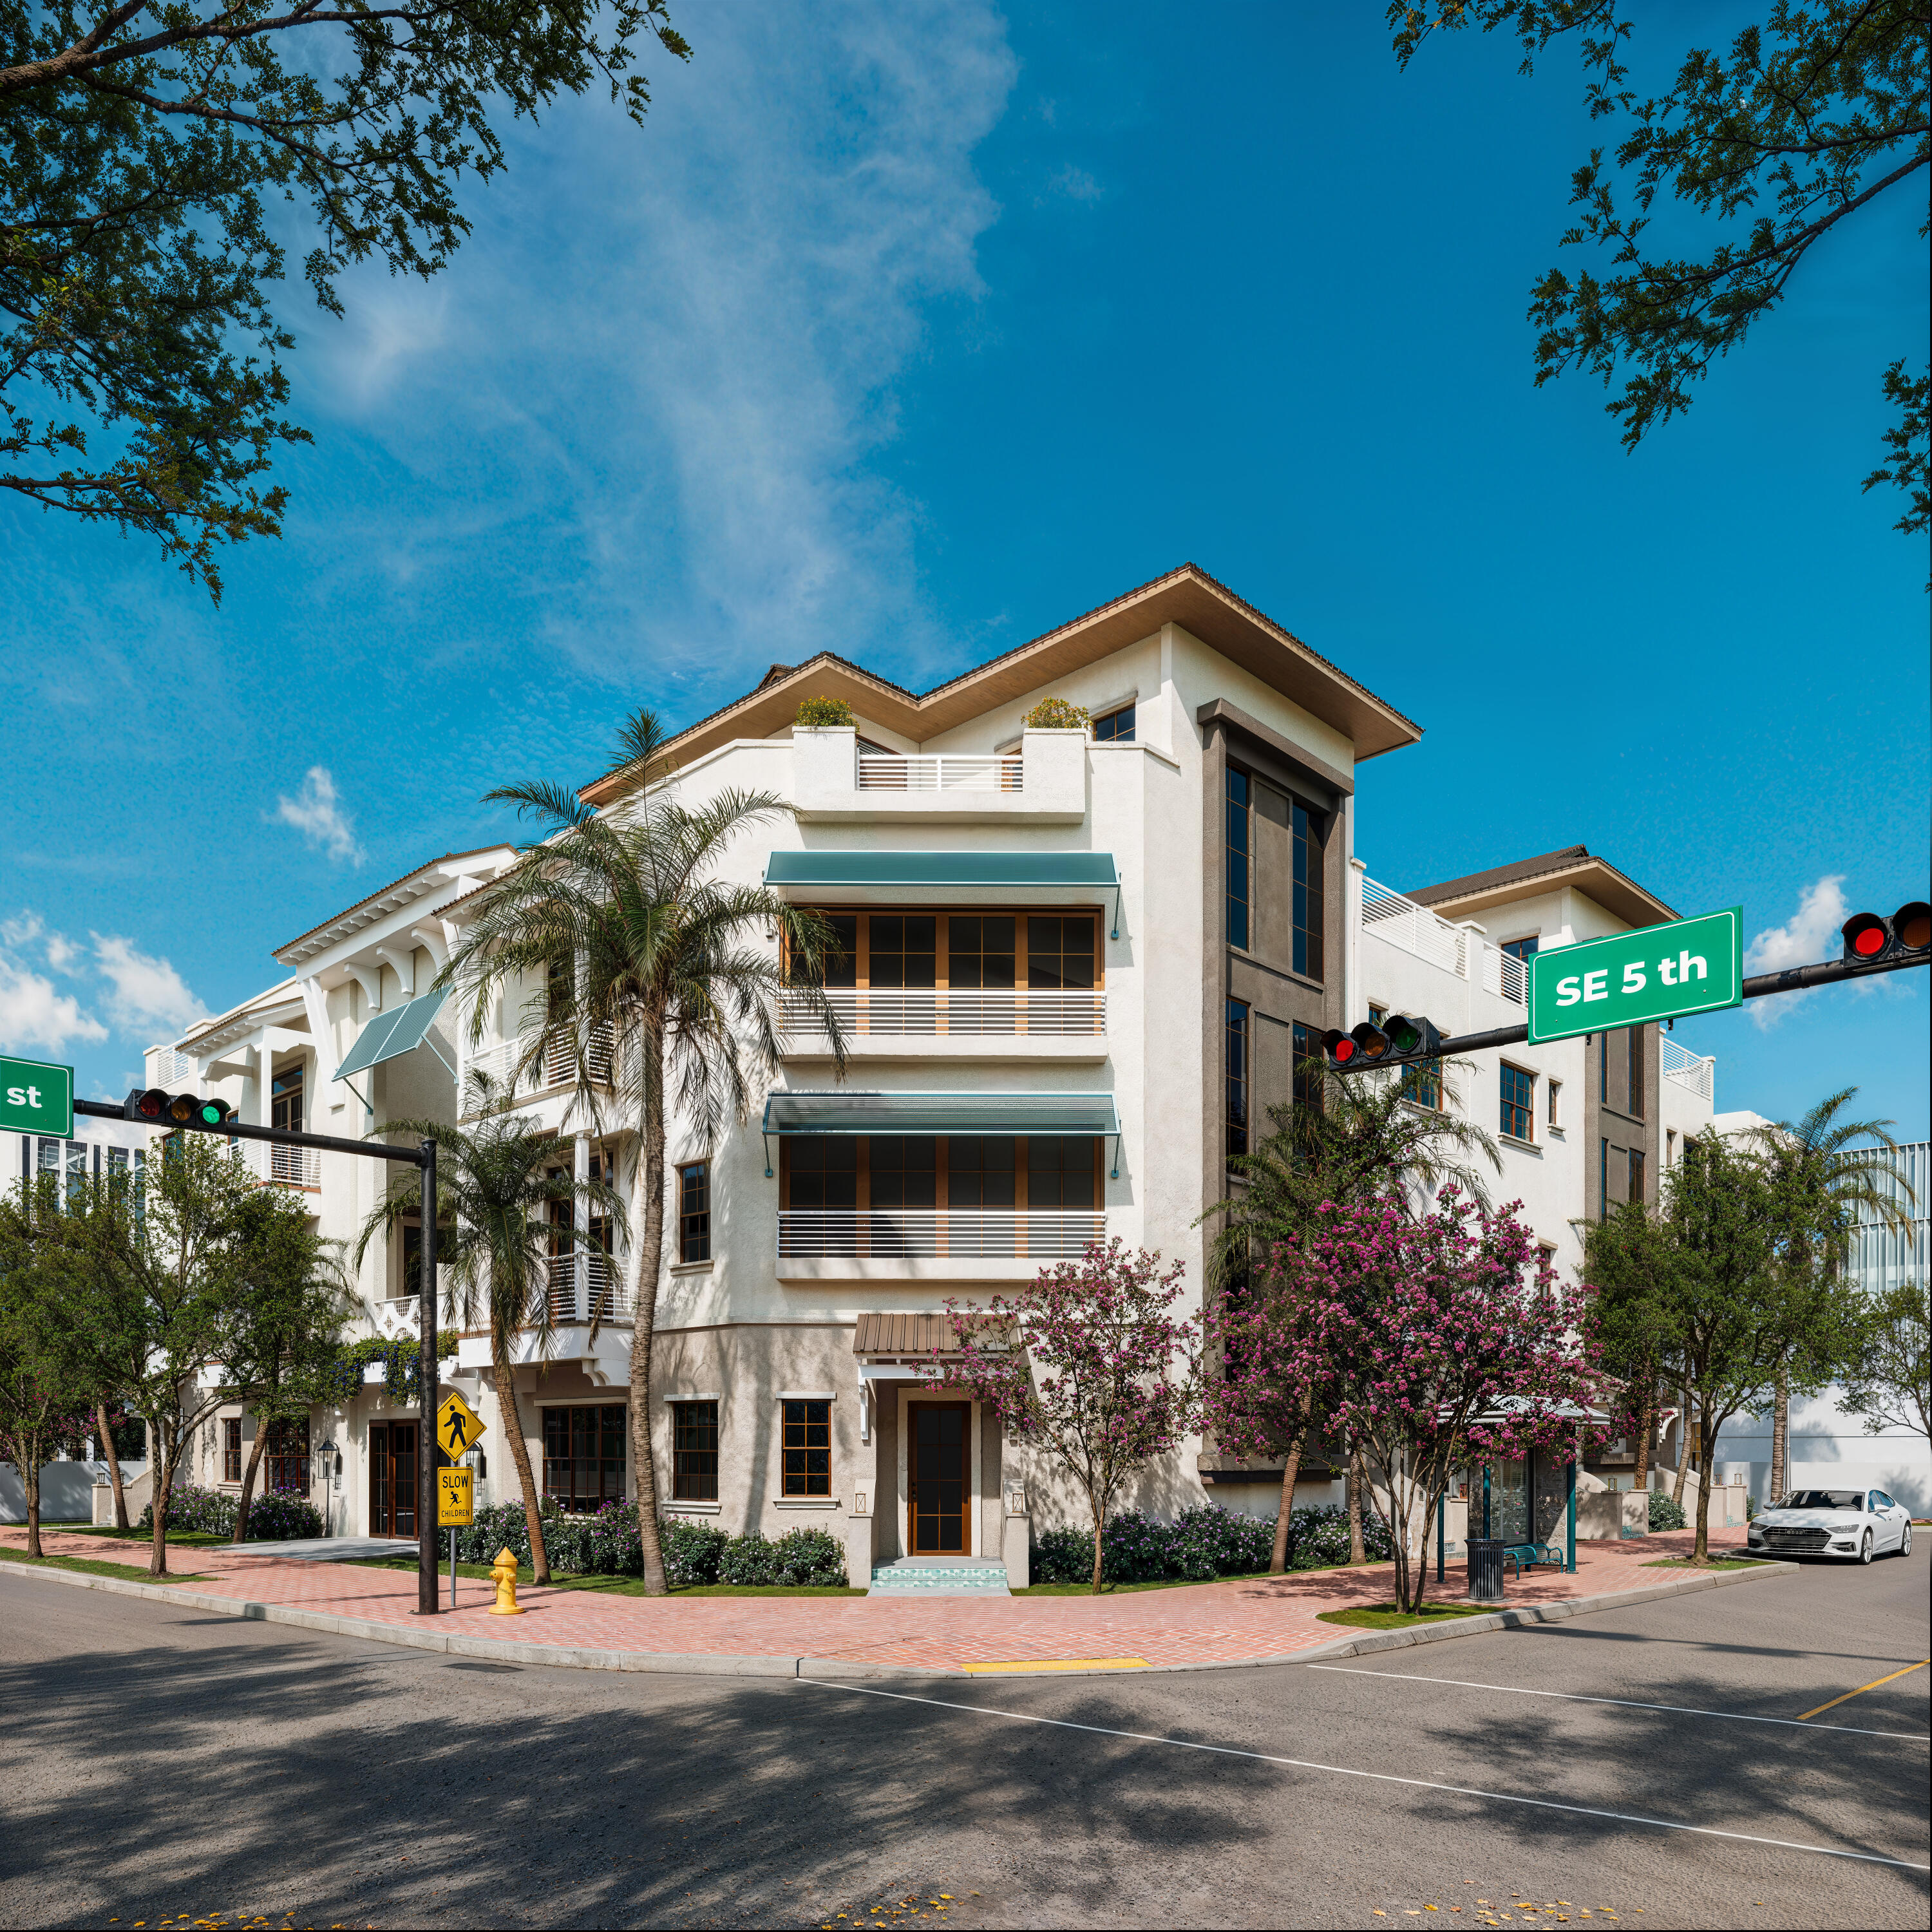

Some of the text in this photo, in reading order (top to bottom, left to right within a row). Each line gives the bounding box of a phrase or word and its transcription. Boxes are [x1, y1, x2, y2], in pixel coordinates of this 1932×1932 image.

[1556, 950, 1707, 1006] SE 5 th
[6, 1086, 43, 1108] st
[442, 1475, 468, 1488] SLOW
